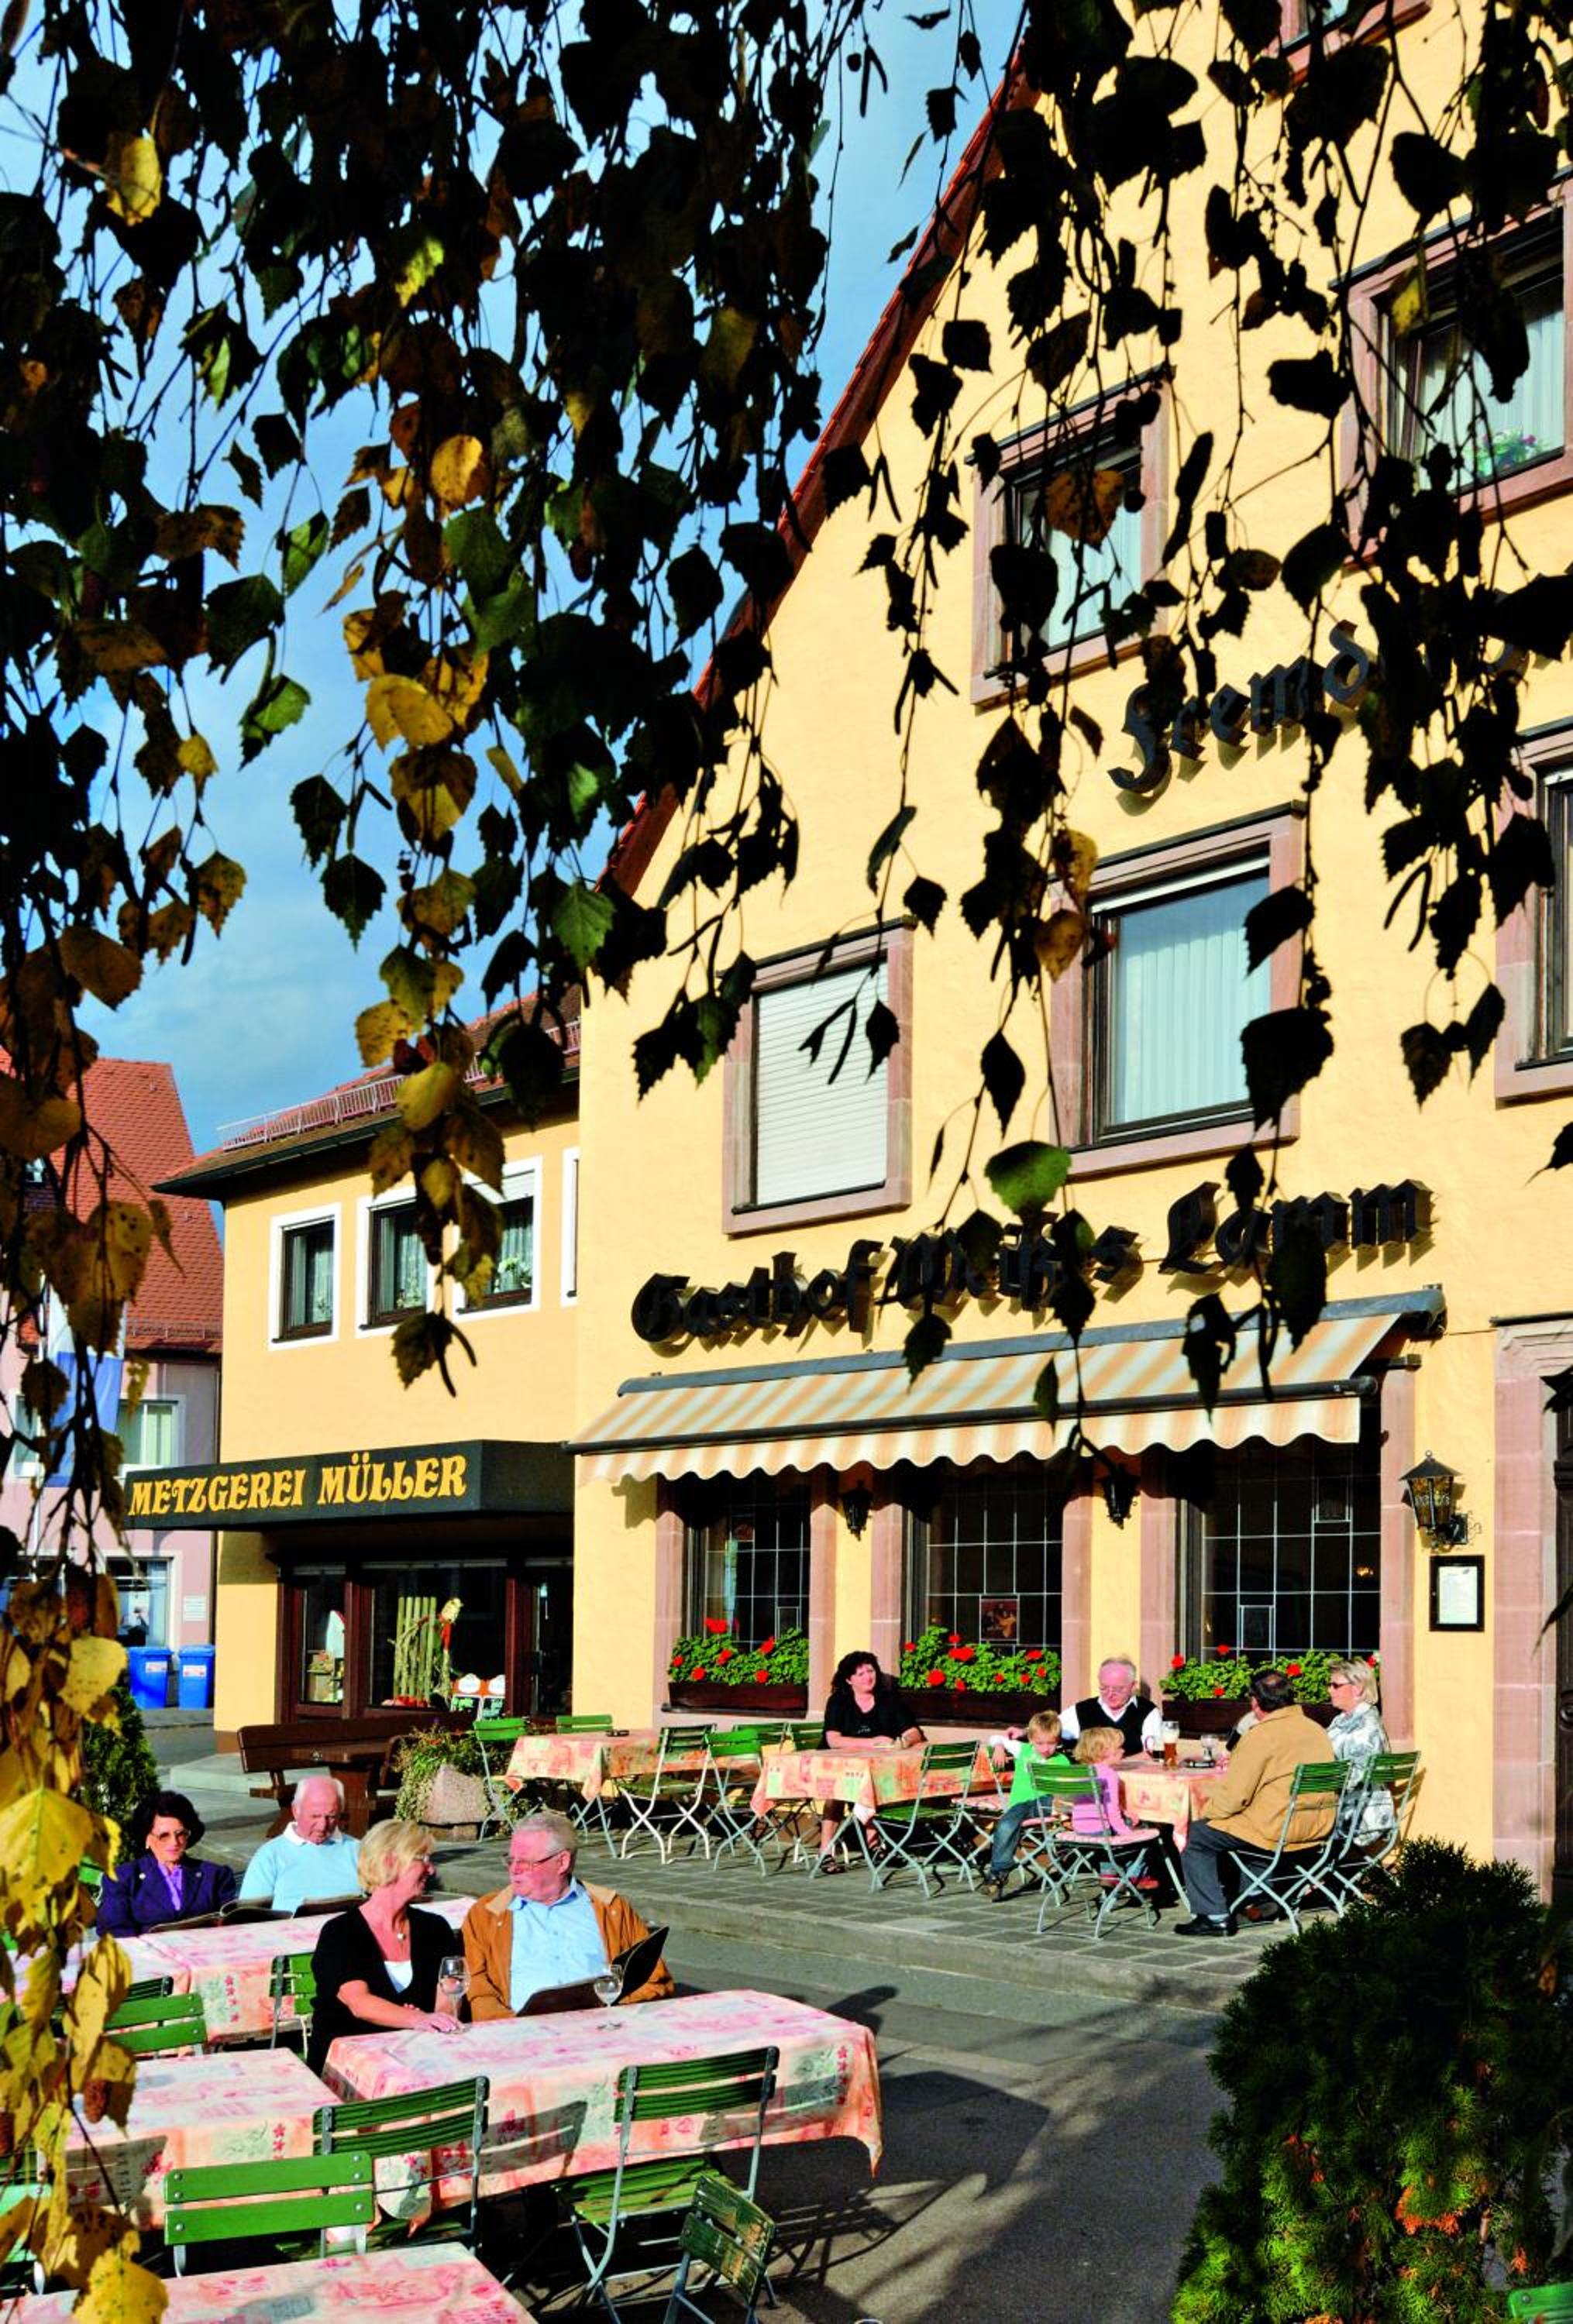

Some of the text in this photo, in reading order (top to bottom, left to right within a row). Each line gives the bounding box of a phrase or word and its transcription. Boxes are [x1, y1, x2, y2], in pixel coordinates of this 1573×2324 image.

[631, 1239, 883, 1342] Gasthof
[1158, 1178, 1434, 1274] Lamm
[128, 1452, 467, 1517] METZGEREI MÜLLER
